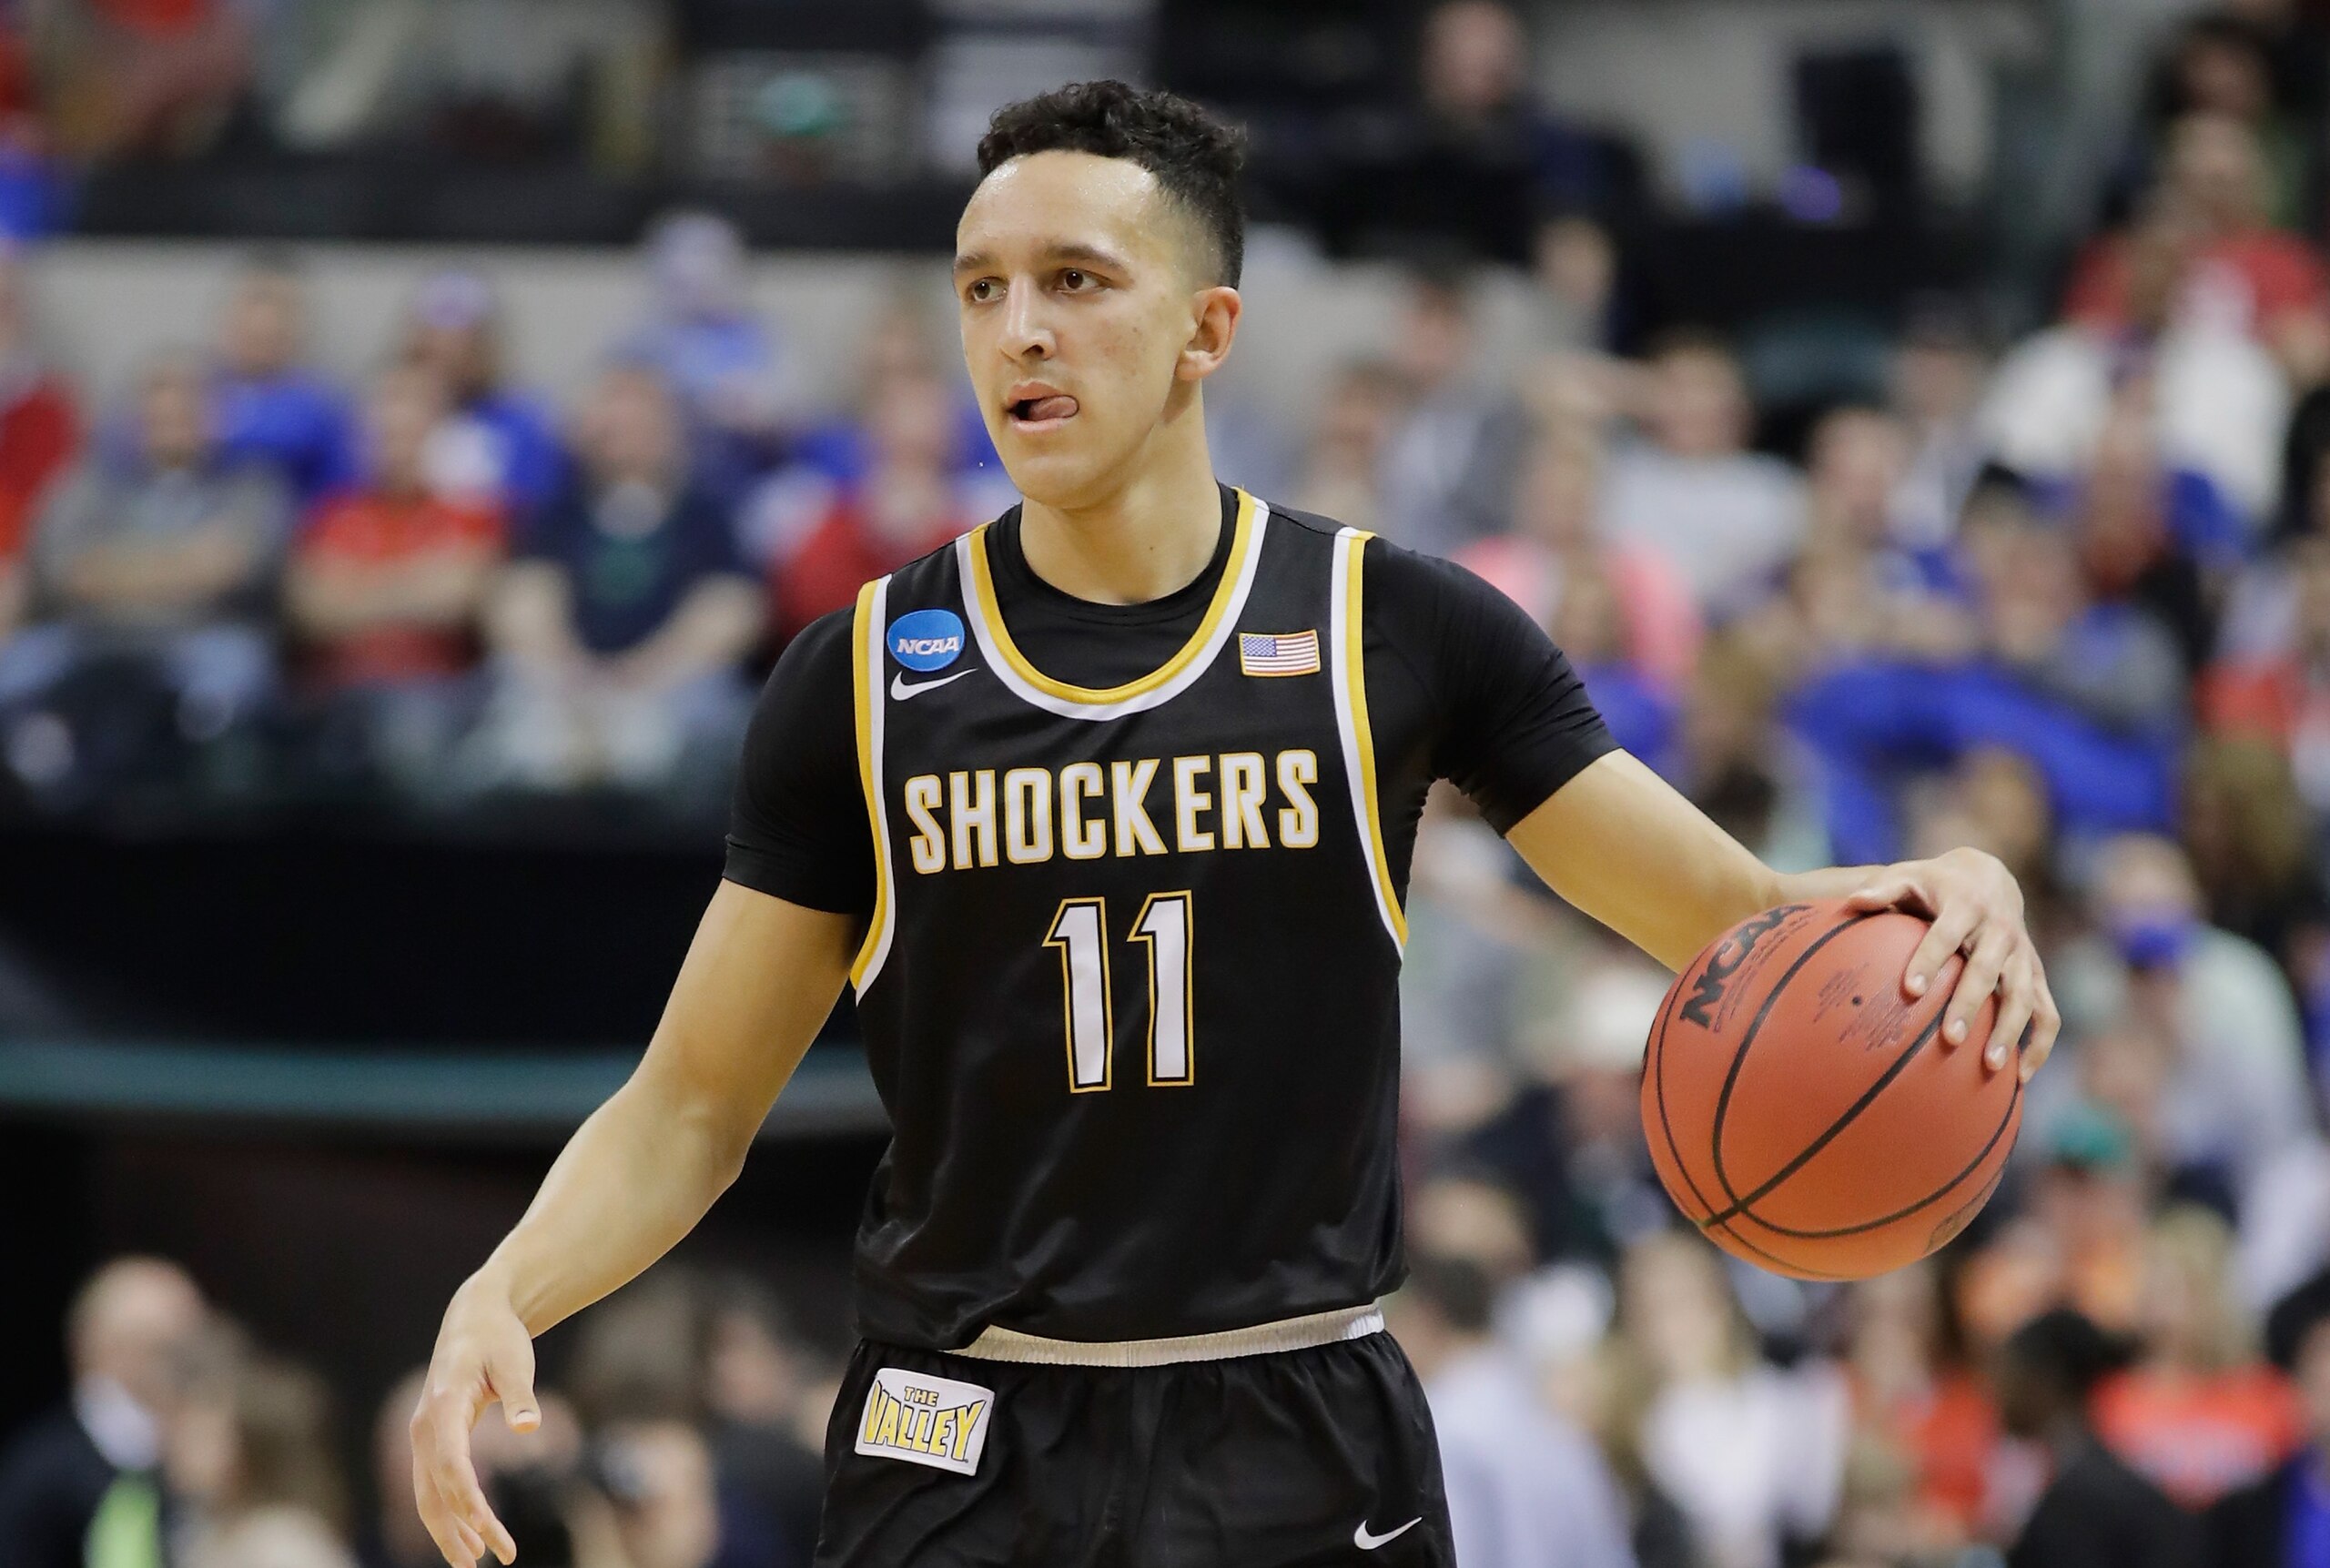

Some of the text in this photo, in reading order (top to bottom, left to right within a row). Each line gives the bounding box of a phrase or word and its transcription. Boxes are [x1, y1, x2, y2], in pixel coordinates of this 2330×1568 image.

[897, 636, 959, 655] NCAA
[905, 750, 1319, 875] SHOCKERS
[1041, 889, 1194, 1094] 11
[864, 1380, 987, 1462] VALLEY
[904, 1386, 939, 1407] THE
